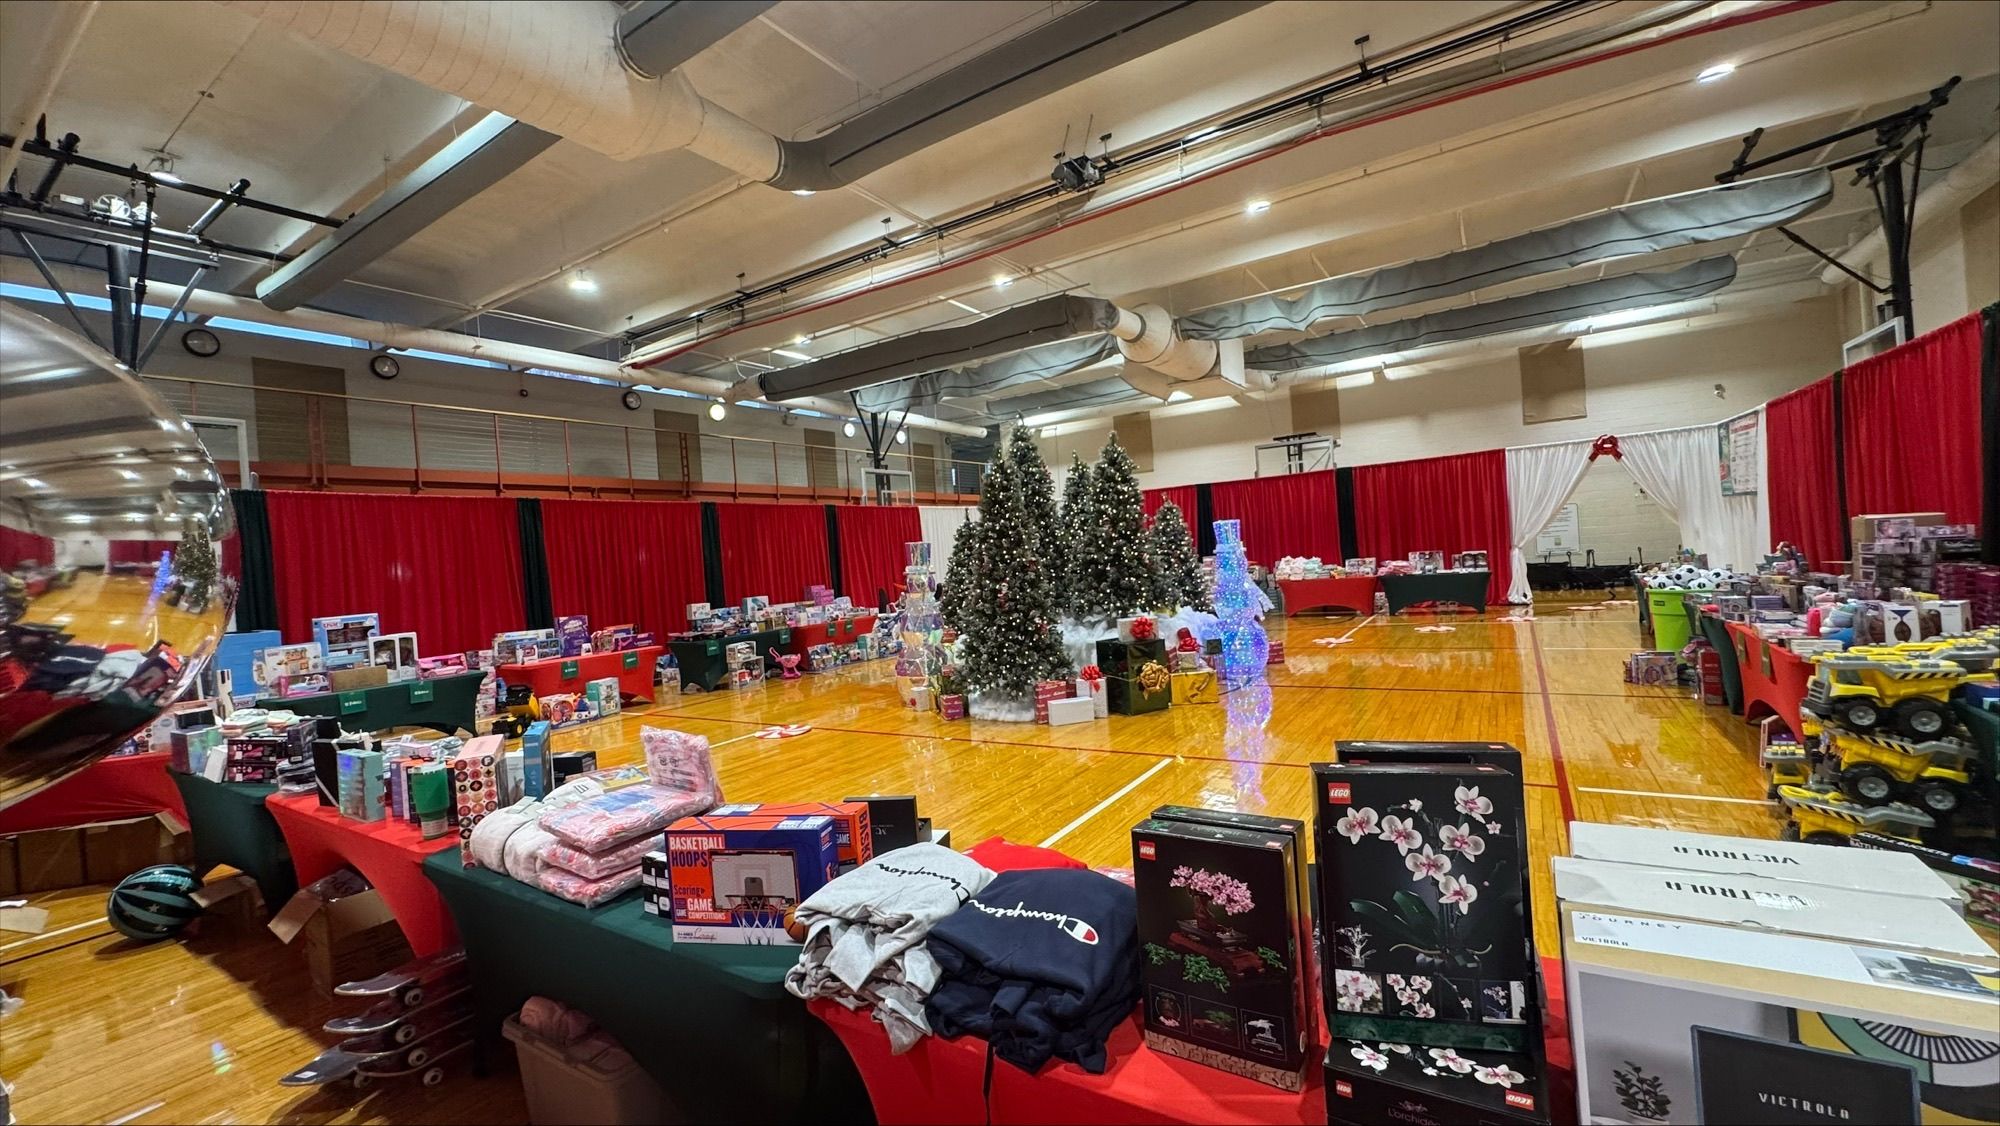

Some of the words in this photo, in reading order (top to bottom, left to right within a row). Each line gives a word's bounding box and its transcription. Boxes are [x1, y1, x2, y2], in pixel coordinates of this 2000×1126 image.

[1329, 788, 1351, 797] LEGO
[669, 837, 724, 850] BASKETBALL
[671, 851, 708, 867] HOOPS
[1672, 845, 1801, 866] VICTROLA
[674, 884, 701, 897] Scoring
[875, 862, 970, 908] Champion
[687, 898, 713, 911] GAME
[688, 912, 727, 920] COMPETITIONS
[968, 898, 1100, 946] Champion
[1581, 936, 1629, 947] VICTROLA
[1758, 1091, 1850, 1120] VICTROLA
